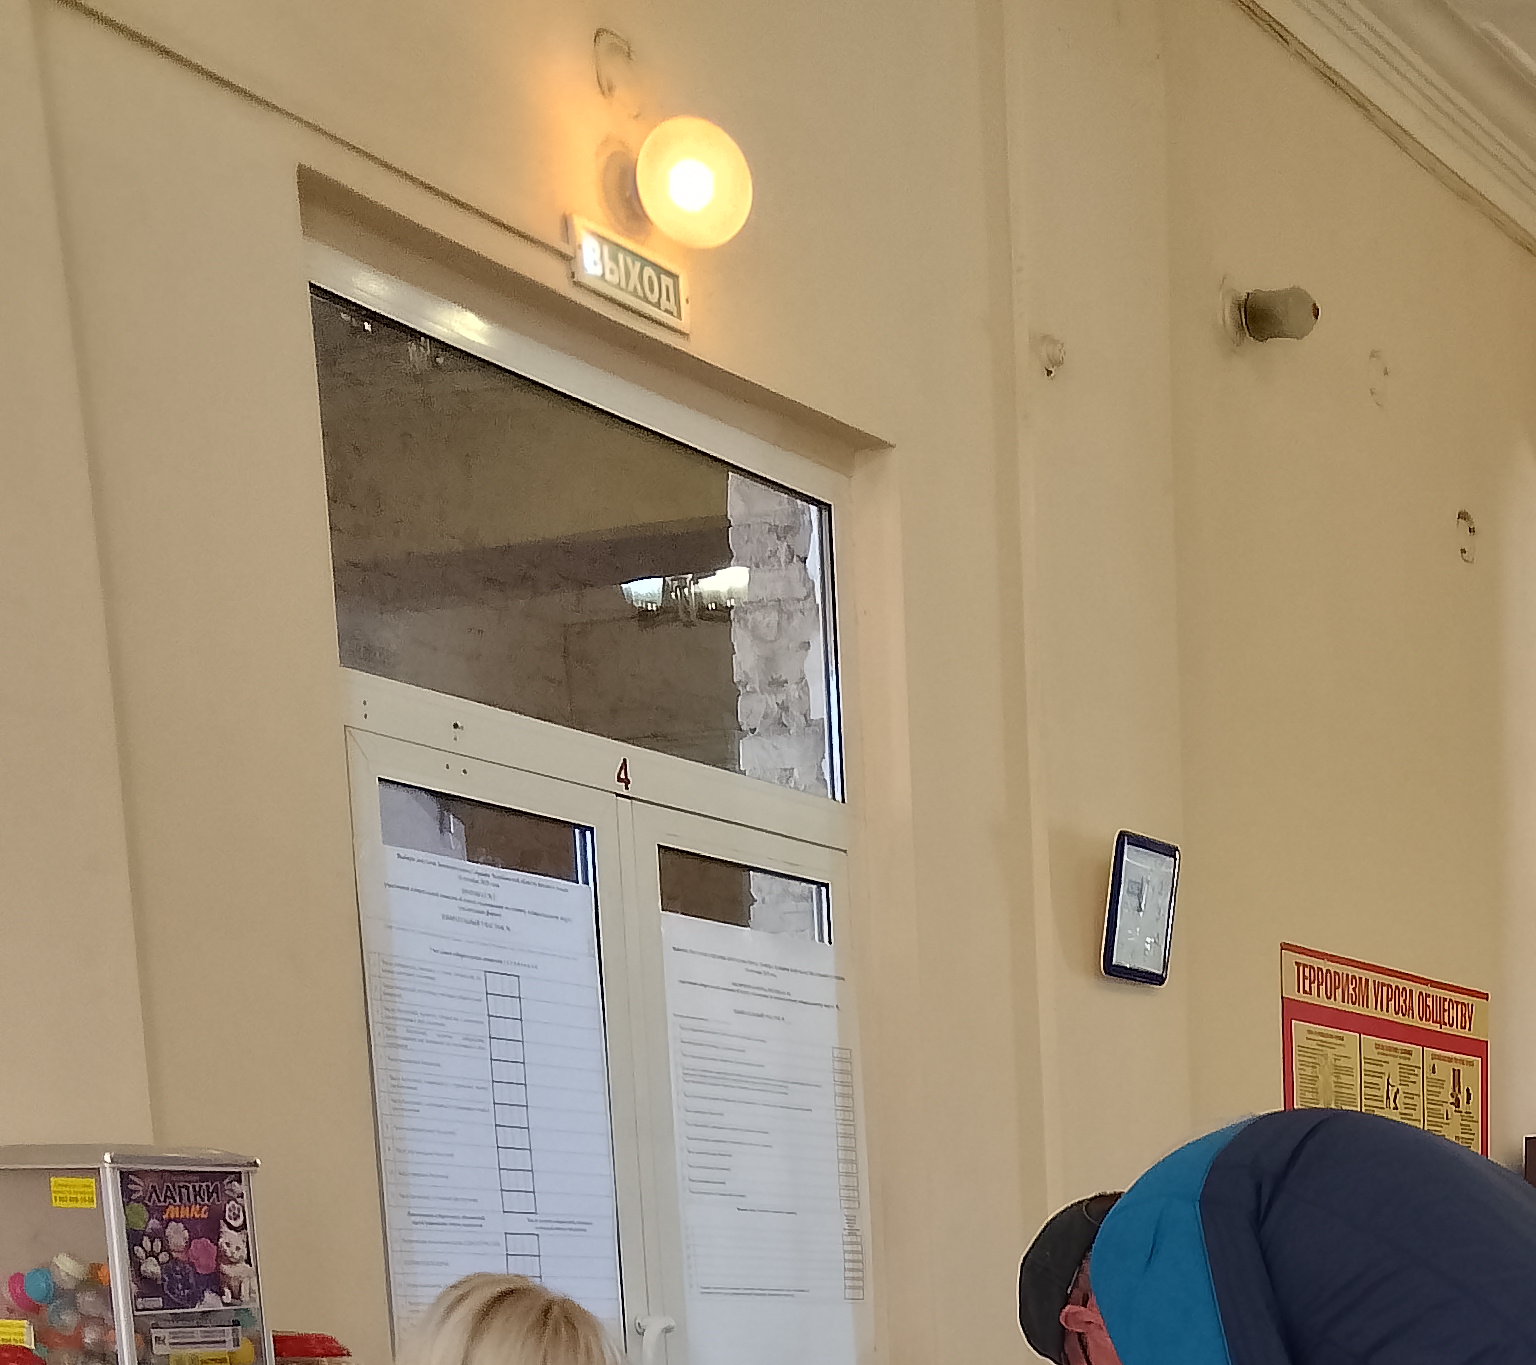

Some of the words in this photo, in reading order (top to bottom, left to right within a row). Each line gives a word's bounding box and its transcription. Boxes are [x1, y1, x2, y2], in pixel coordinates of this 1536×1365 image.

[582, 232, 677, 316] ВЫХОД
[617, 757, 631, 790] 4
[1294, 961, 1370, 1009] ТЕРРОРИЗМ
[1373, 979, 1415, 1019] УГРОЗА
[1417, 990, 1475, 1032] ОБЩЕСТВУ
[146, 1180, 222, 1206] ЛАПКИ
